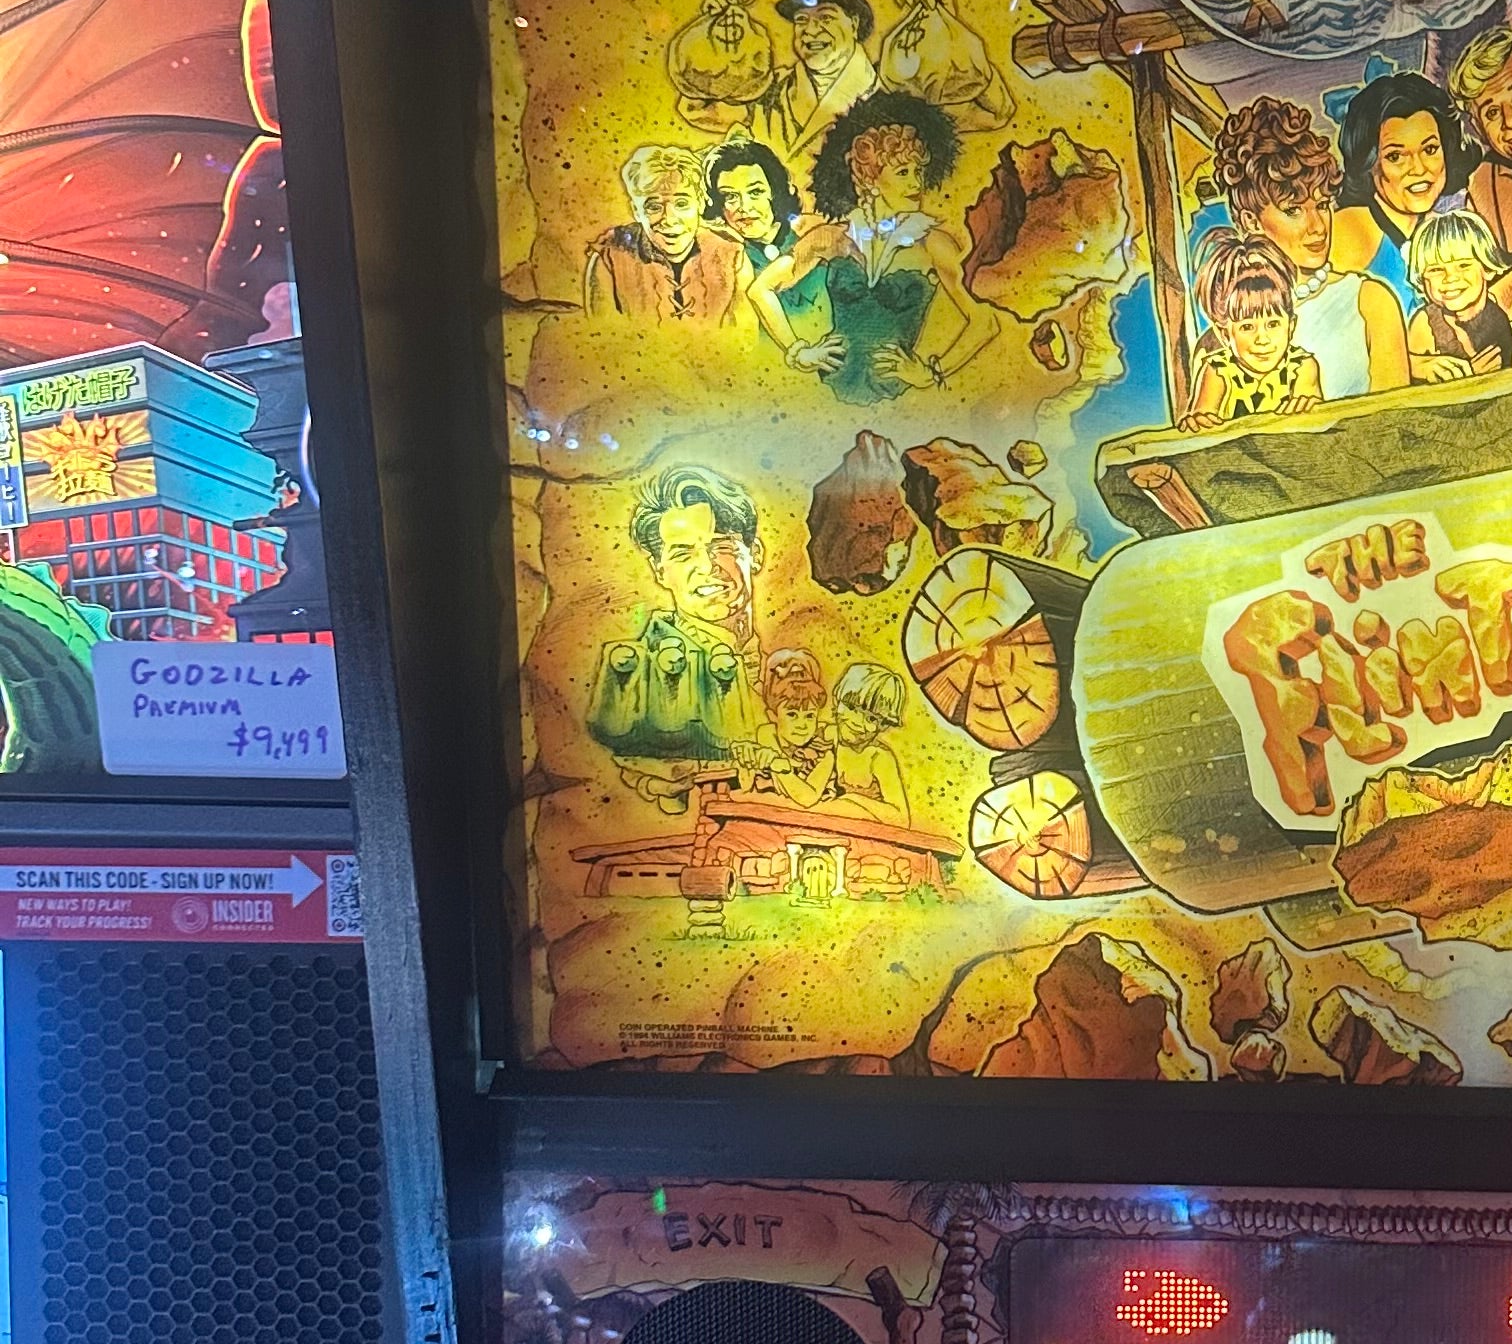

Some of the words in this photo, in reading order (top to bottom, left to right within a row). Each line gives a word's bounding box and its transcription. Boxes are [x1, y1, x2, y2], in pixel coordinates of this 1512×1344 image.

[1305, 518, 1430, 603] THE
[131, 658, 312, 686] GODZILLA
[133, 693, 242, 718] PREMIUM
[227, 722, 328, 760] $9,499
[16, 870, 61, 889] SCAN
[64, 871, 103, 889] THIS
[106, 871, 149, 889] CODE
[160, 871, 200, 890] SIGN
[203, 872, 225, 890] UP
[230, 872, 274, 891] NOW!
[18, 898, 43, 911] NEW
[47, 898, 79, 912] WAYS
[82, 899, 95, 912] TO
[98, 899, 132, 912] PLAY!
[213, 899, 274, 923] INSIDER
[16, 914, 53, 928] TRACK
[56, 915, 86, 928] YOUR
[88, 915, 152, 929] PROGRESS!
[619, 1023, 642, 1032] COIN
[644, 1023, 694, 1032] OPERATED
[696, 1024, 735, 1033] PINBALL
[737, 1025, 778, 1034] MACHINE
[663, 1212, 784, 1252] EXIT
